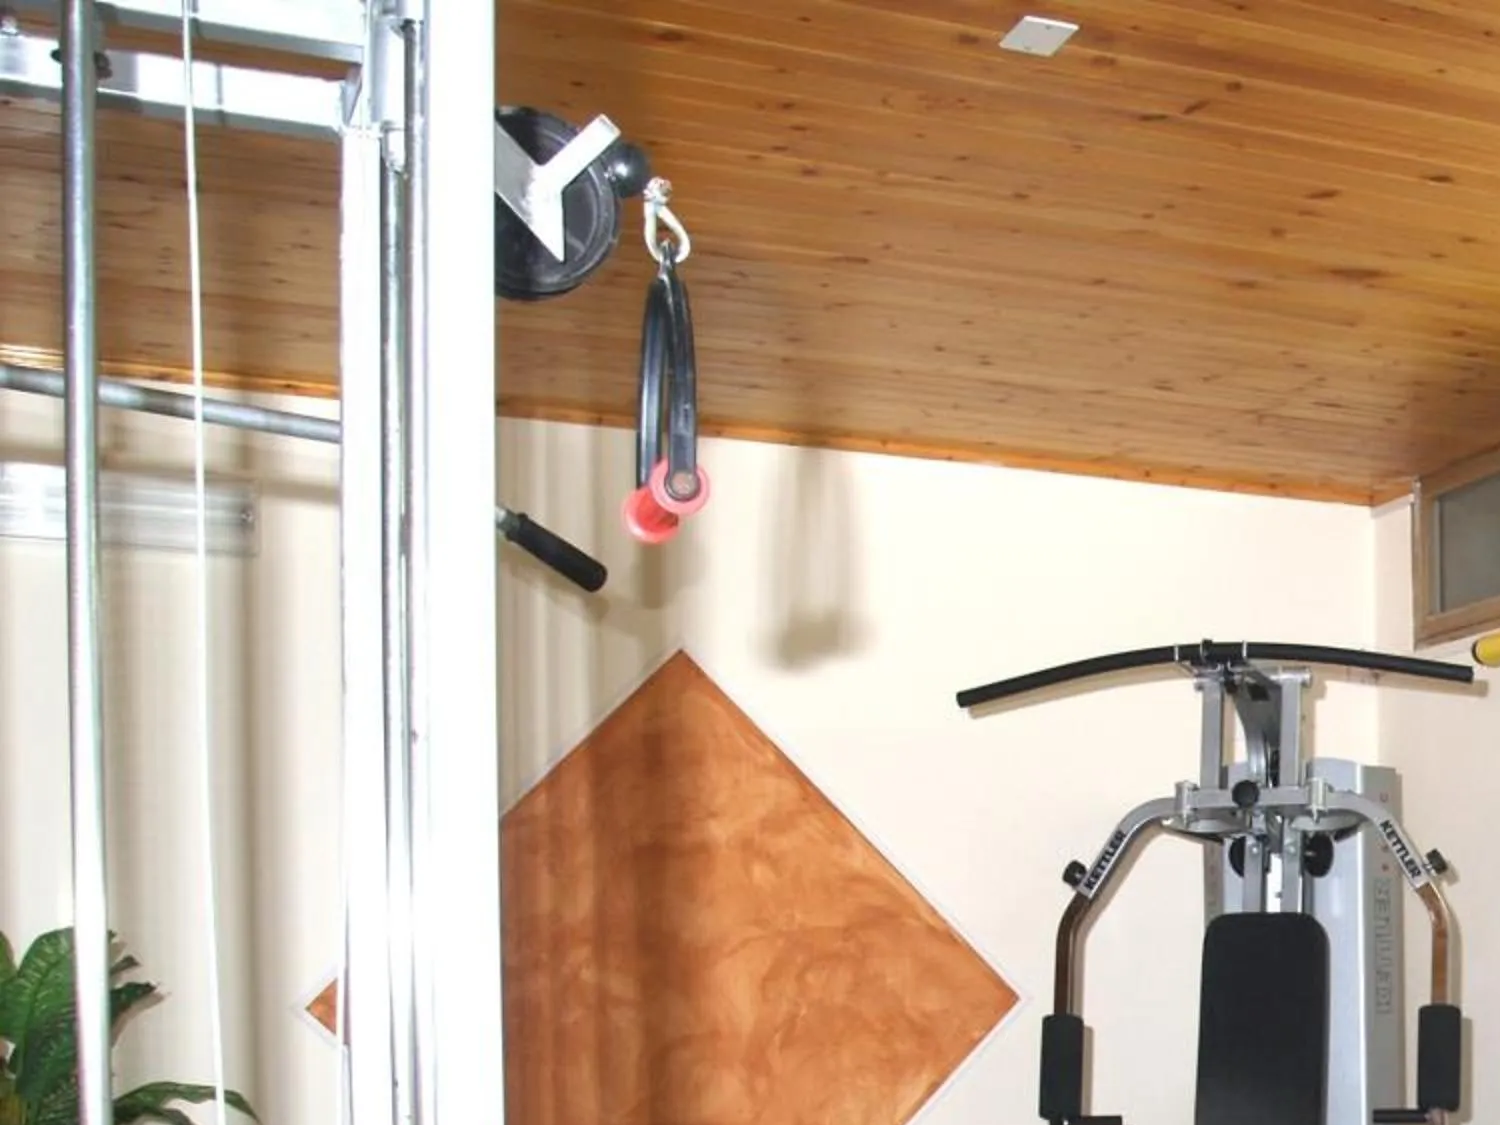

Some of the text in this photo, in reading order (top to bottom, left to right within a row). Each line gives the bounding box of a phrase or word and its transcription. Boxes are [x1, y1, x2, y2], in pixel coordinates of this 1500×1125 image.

[1084, 830, 1126, 890] KETTLER
[1381, 820, 1421, 878] KETTLER
[1374, 878, 1393, 1014] KETTLER
